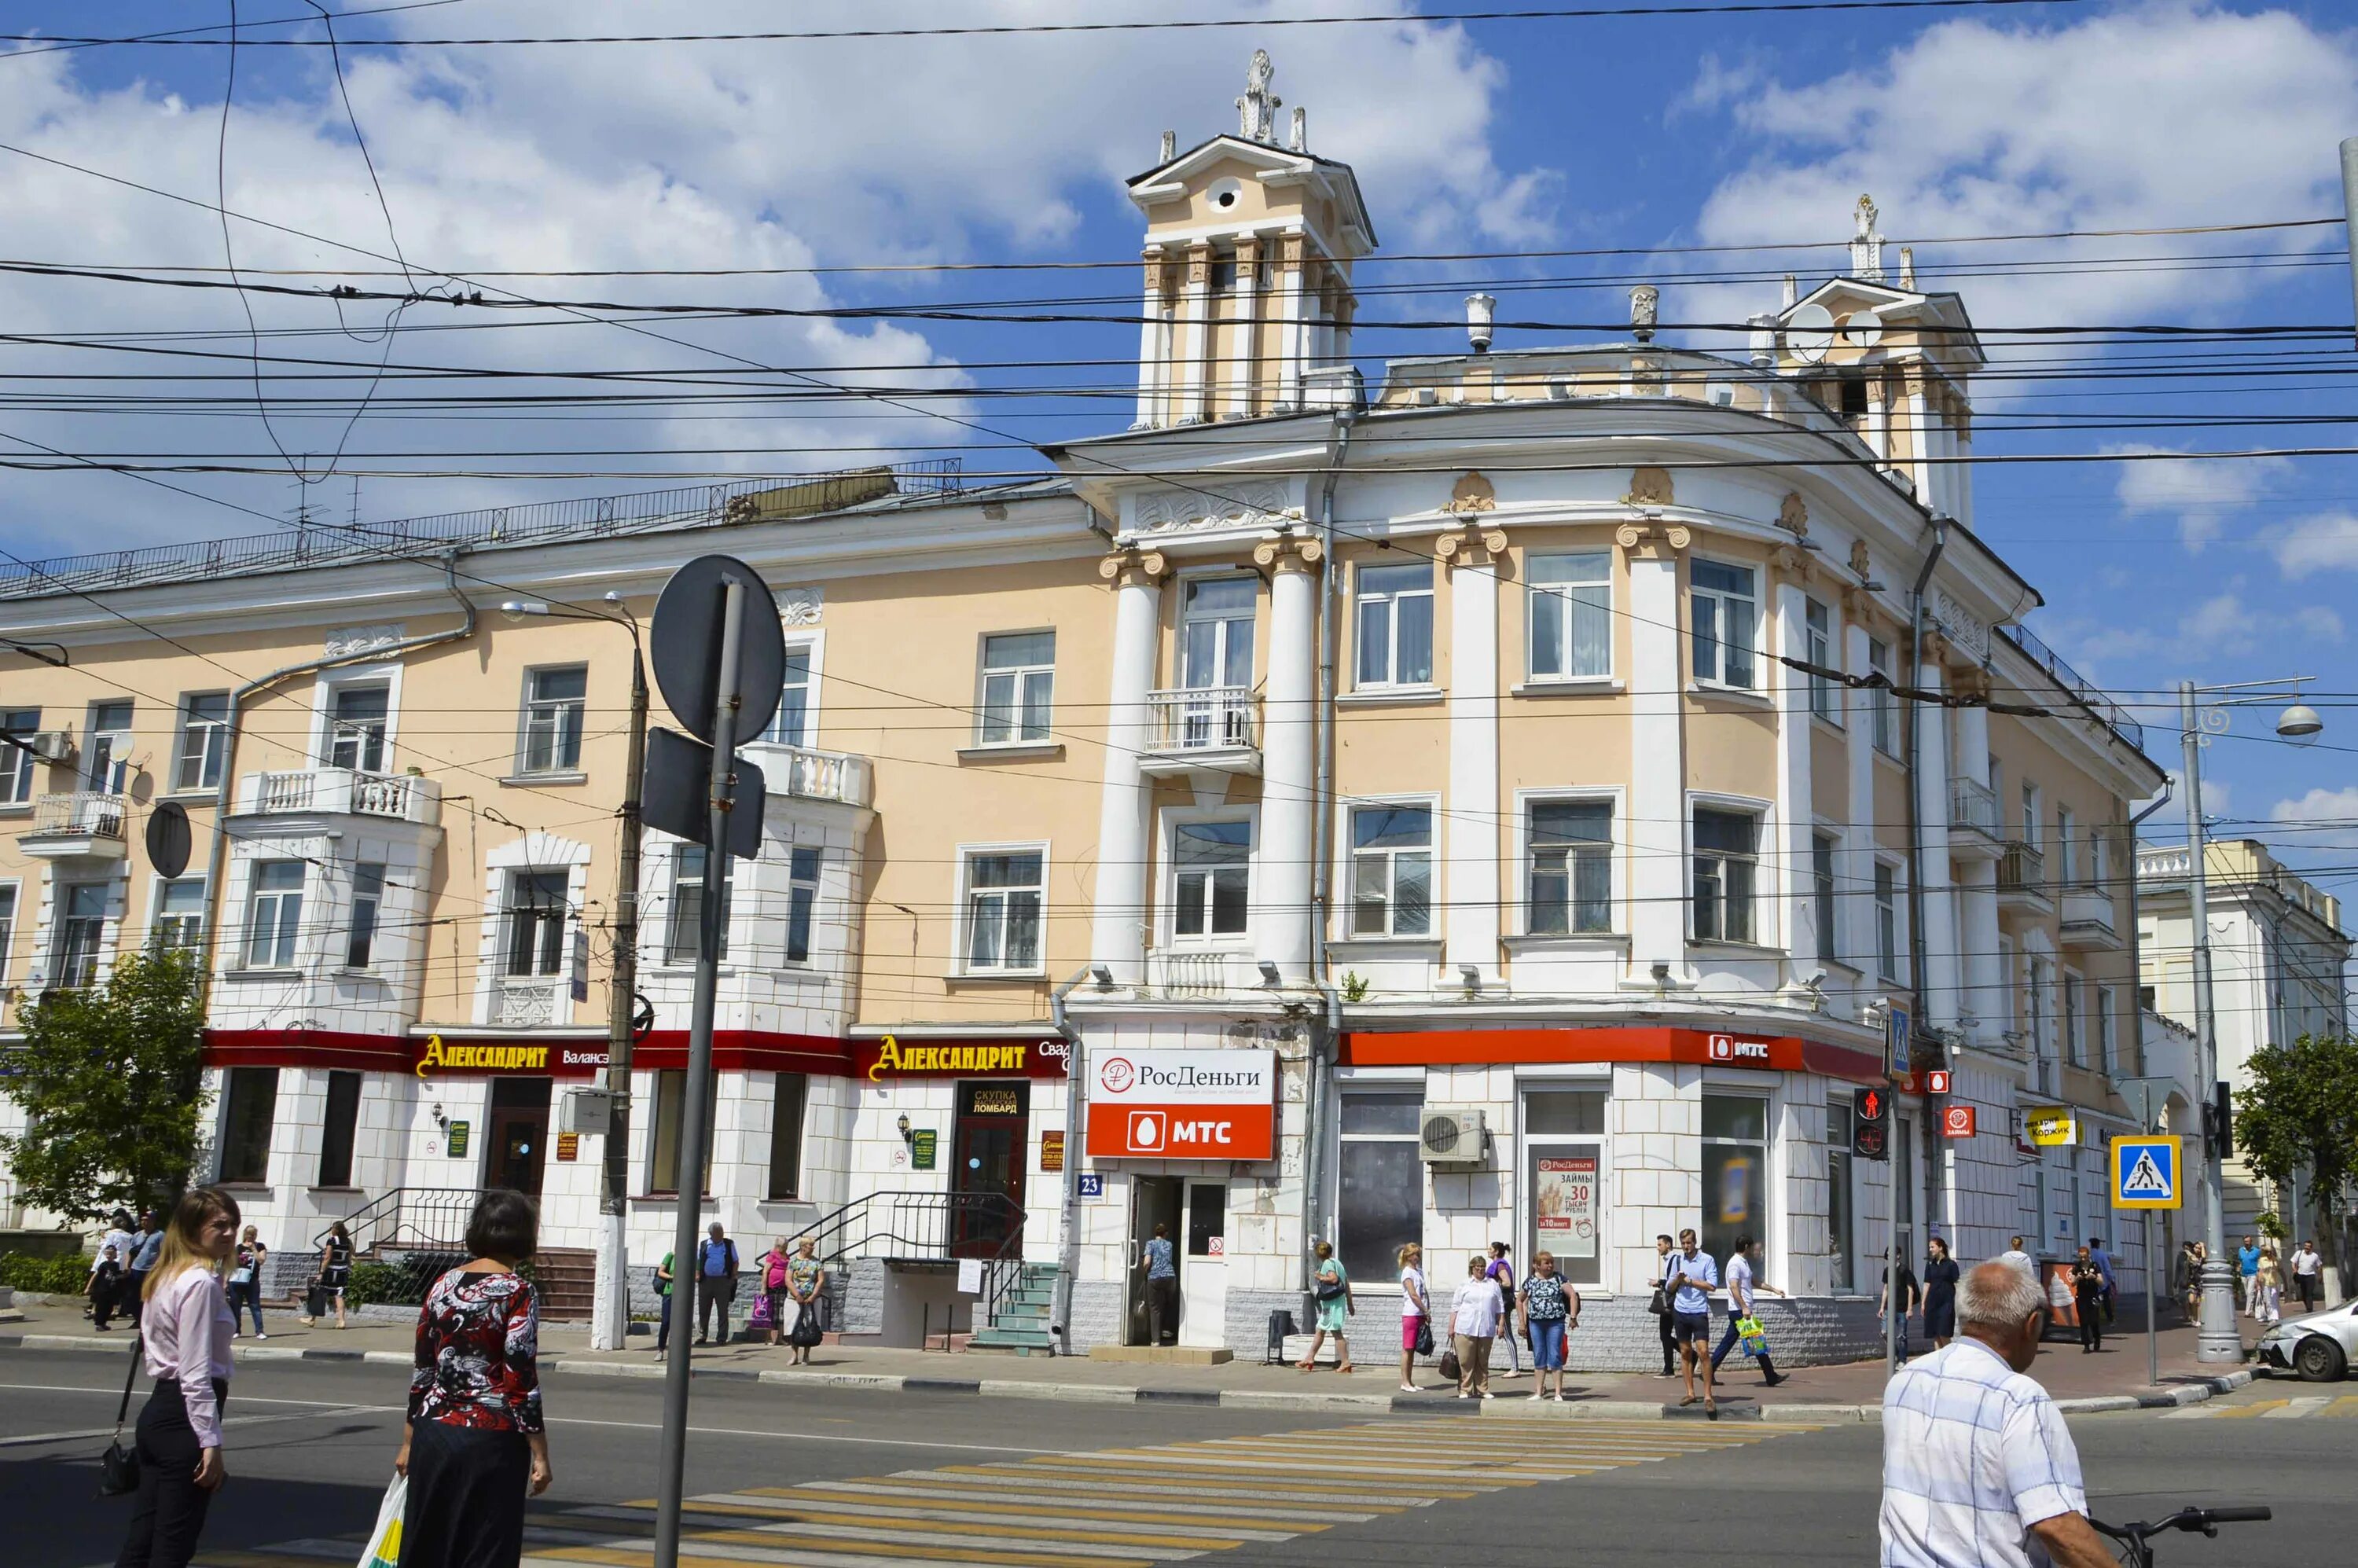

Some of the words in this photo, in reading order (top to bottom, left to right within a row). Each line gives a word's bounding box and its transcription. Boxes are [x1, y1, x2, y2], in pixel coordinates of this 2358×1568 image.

[563, 1049, 610, 1064] Валансэ
[1734, 1042, 1768, 1058] МТС
[1139, 1066, 1261, 1088] РосДеньги
[975, 1090, 1016, 1100] СКУПКА
[973, 1104, 1017, 1114] ЛОМБАРД
[1173, 1121, 1231, 1144] МТС
[2032, 1126, 2070, 1139] Коржик
[1860, 1130, 1882, 1151] 42
[1082, 1177, 1098, 1193] 23
[1561, 1173, 1593, 1184] ЗАЙМЫ
[1570, 1185, 1589, 1200] 30
